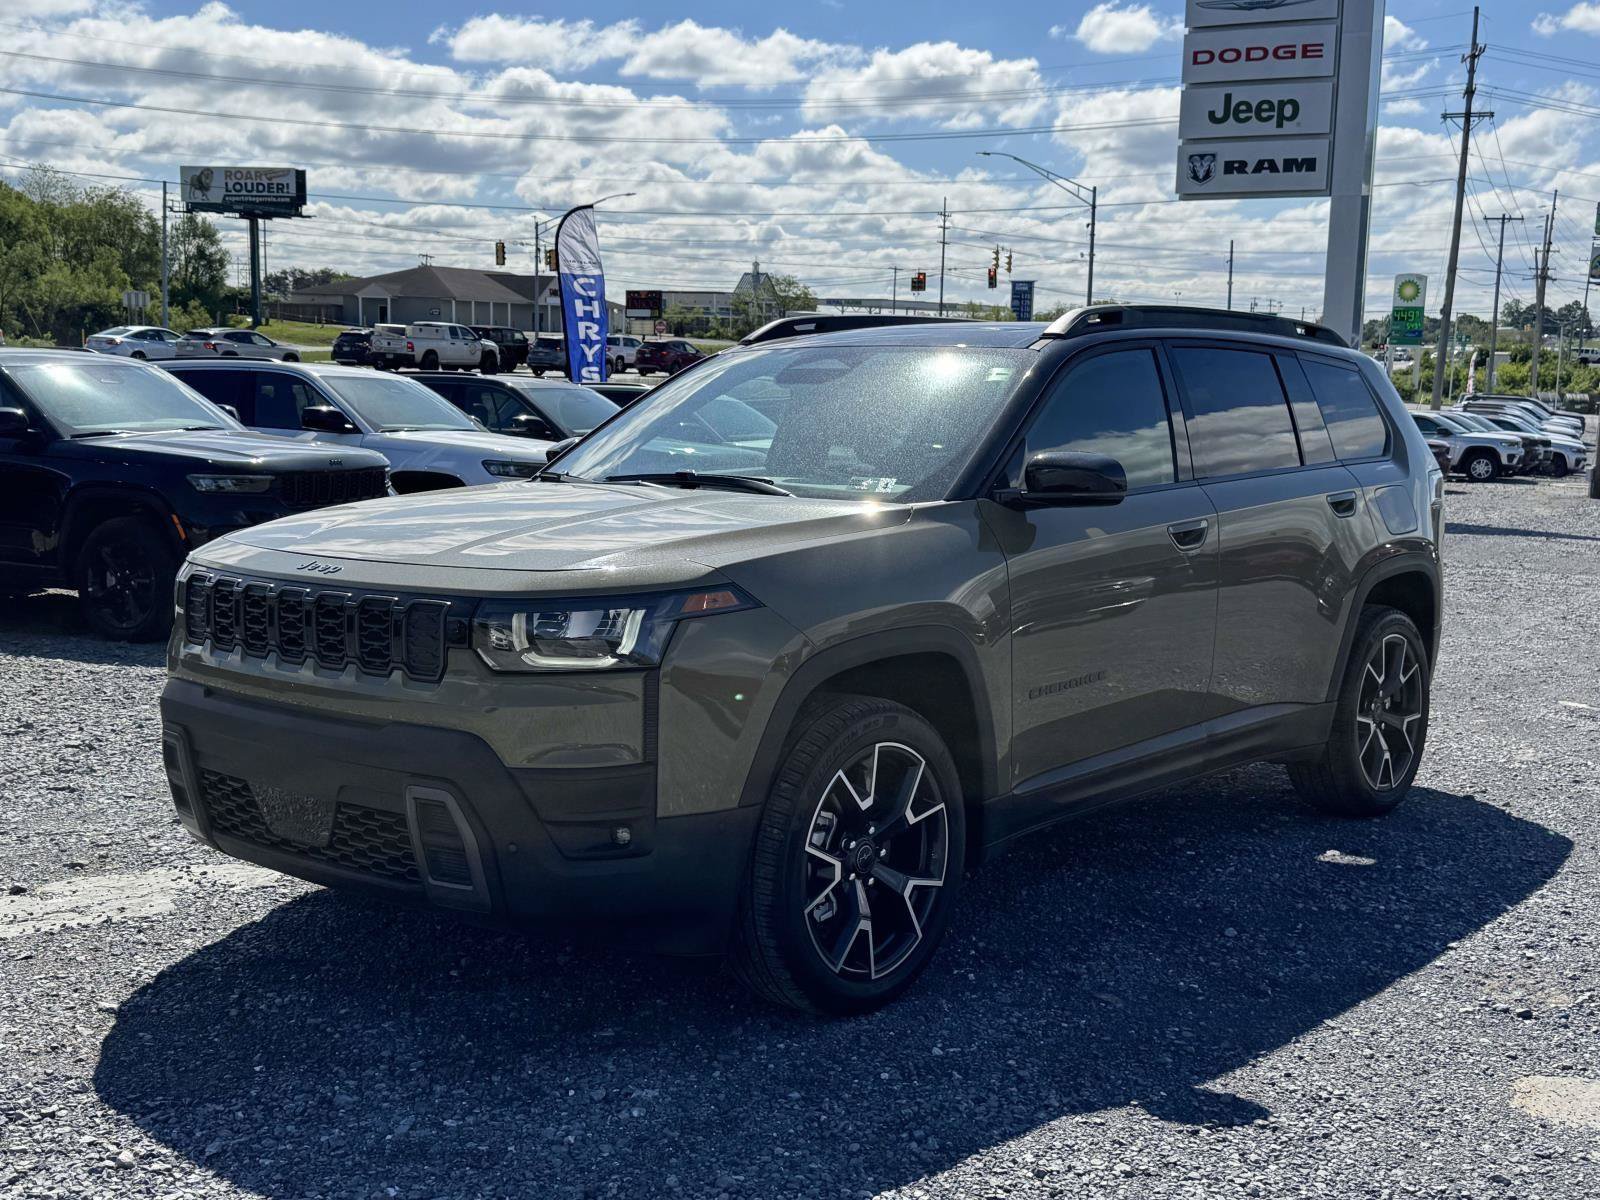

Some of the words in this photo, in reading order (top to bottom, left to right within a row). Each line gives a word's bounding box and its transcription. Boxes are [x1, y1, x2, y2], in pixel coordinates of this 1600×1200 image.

[1192, 43, 1324, 65] DODGE
[1208, 93, 1300, 128] Jeep
[224, 169, 263, 181] ROAR
[1223, 158, 1316, 175] RAM
[225, 182, 290, 194] LOUDER!
[296, 560, 342, 575] Jeep
[1029, 671, 1105, 699] CHEROKEE
